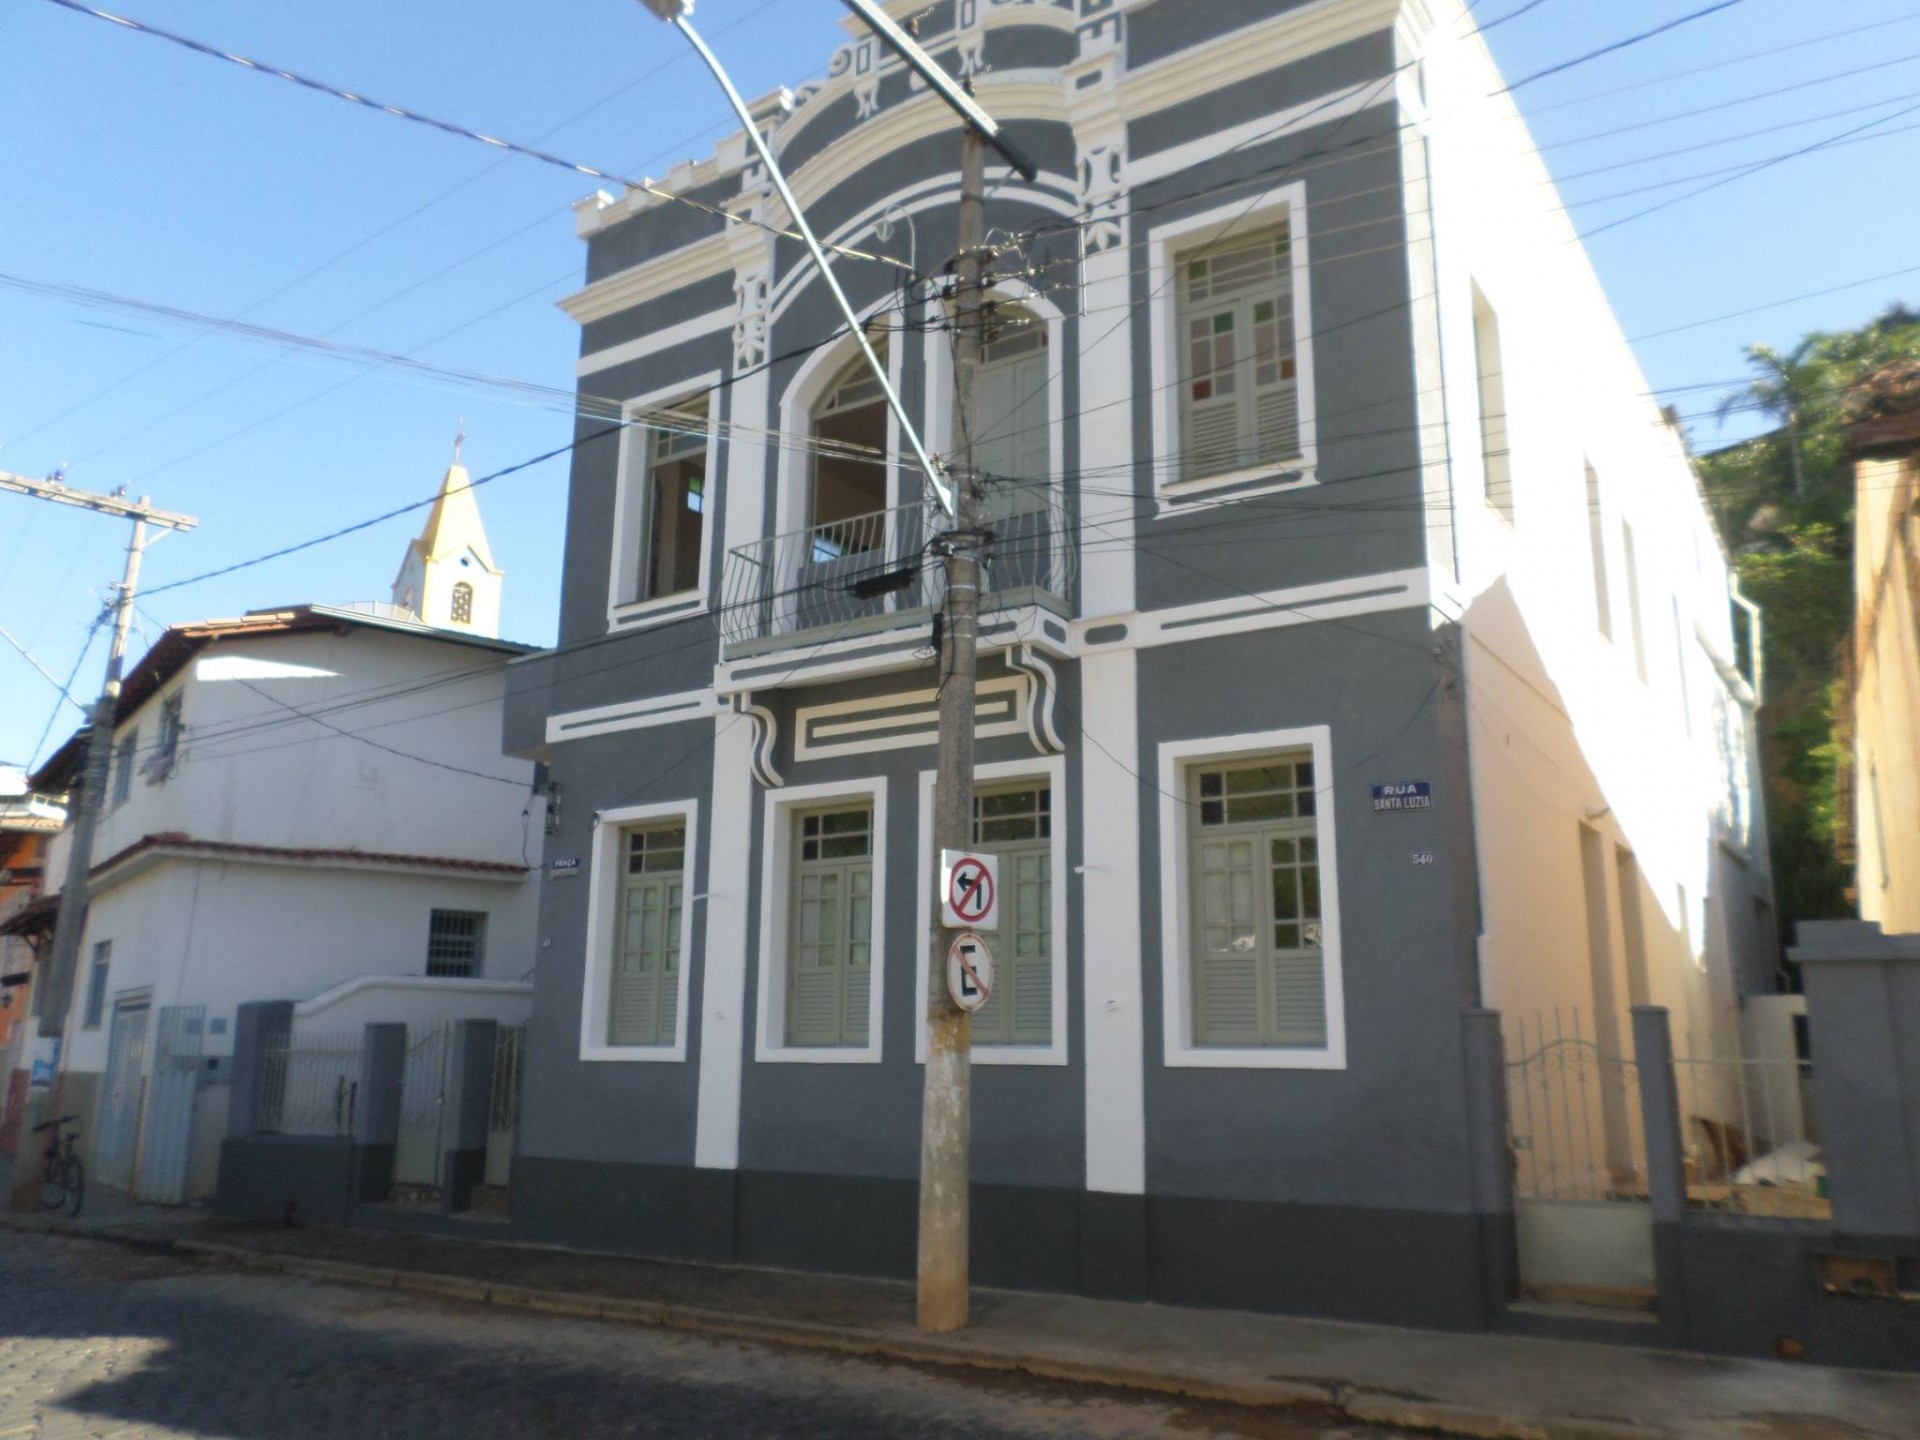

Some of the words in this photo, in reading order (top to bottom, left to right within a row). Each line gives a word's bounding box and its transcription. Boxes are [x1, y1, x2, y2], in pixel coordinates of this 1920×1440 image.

[1384, 784, 1417, 796] RUA
[1374, 798, 1402, 811] SANTA
[1403, 796, 1431, 809] LUZIA
[1412, 854, 1433, 865] 540
[960, 945, 978, 996] E
